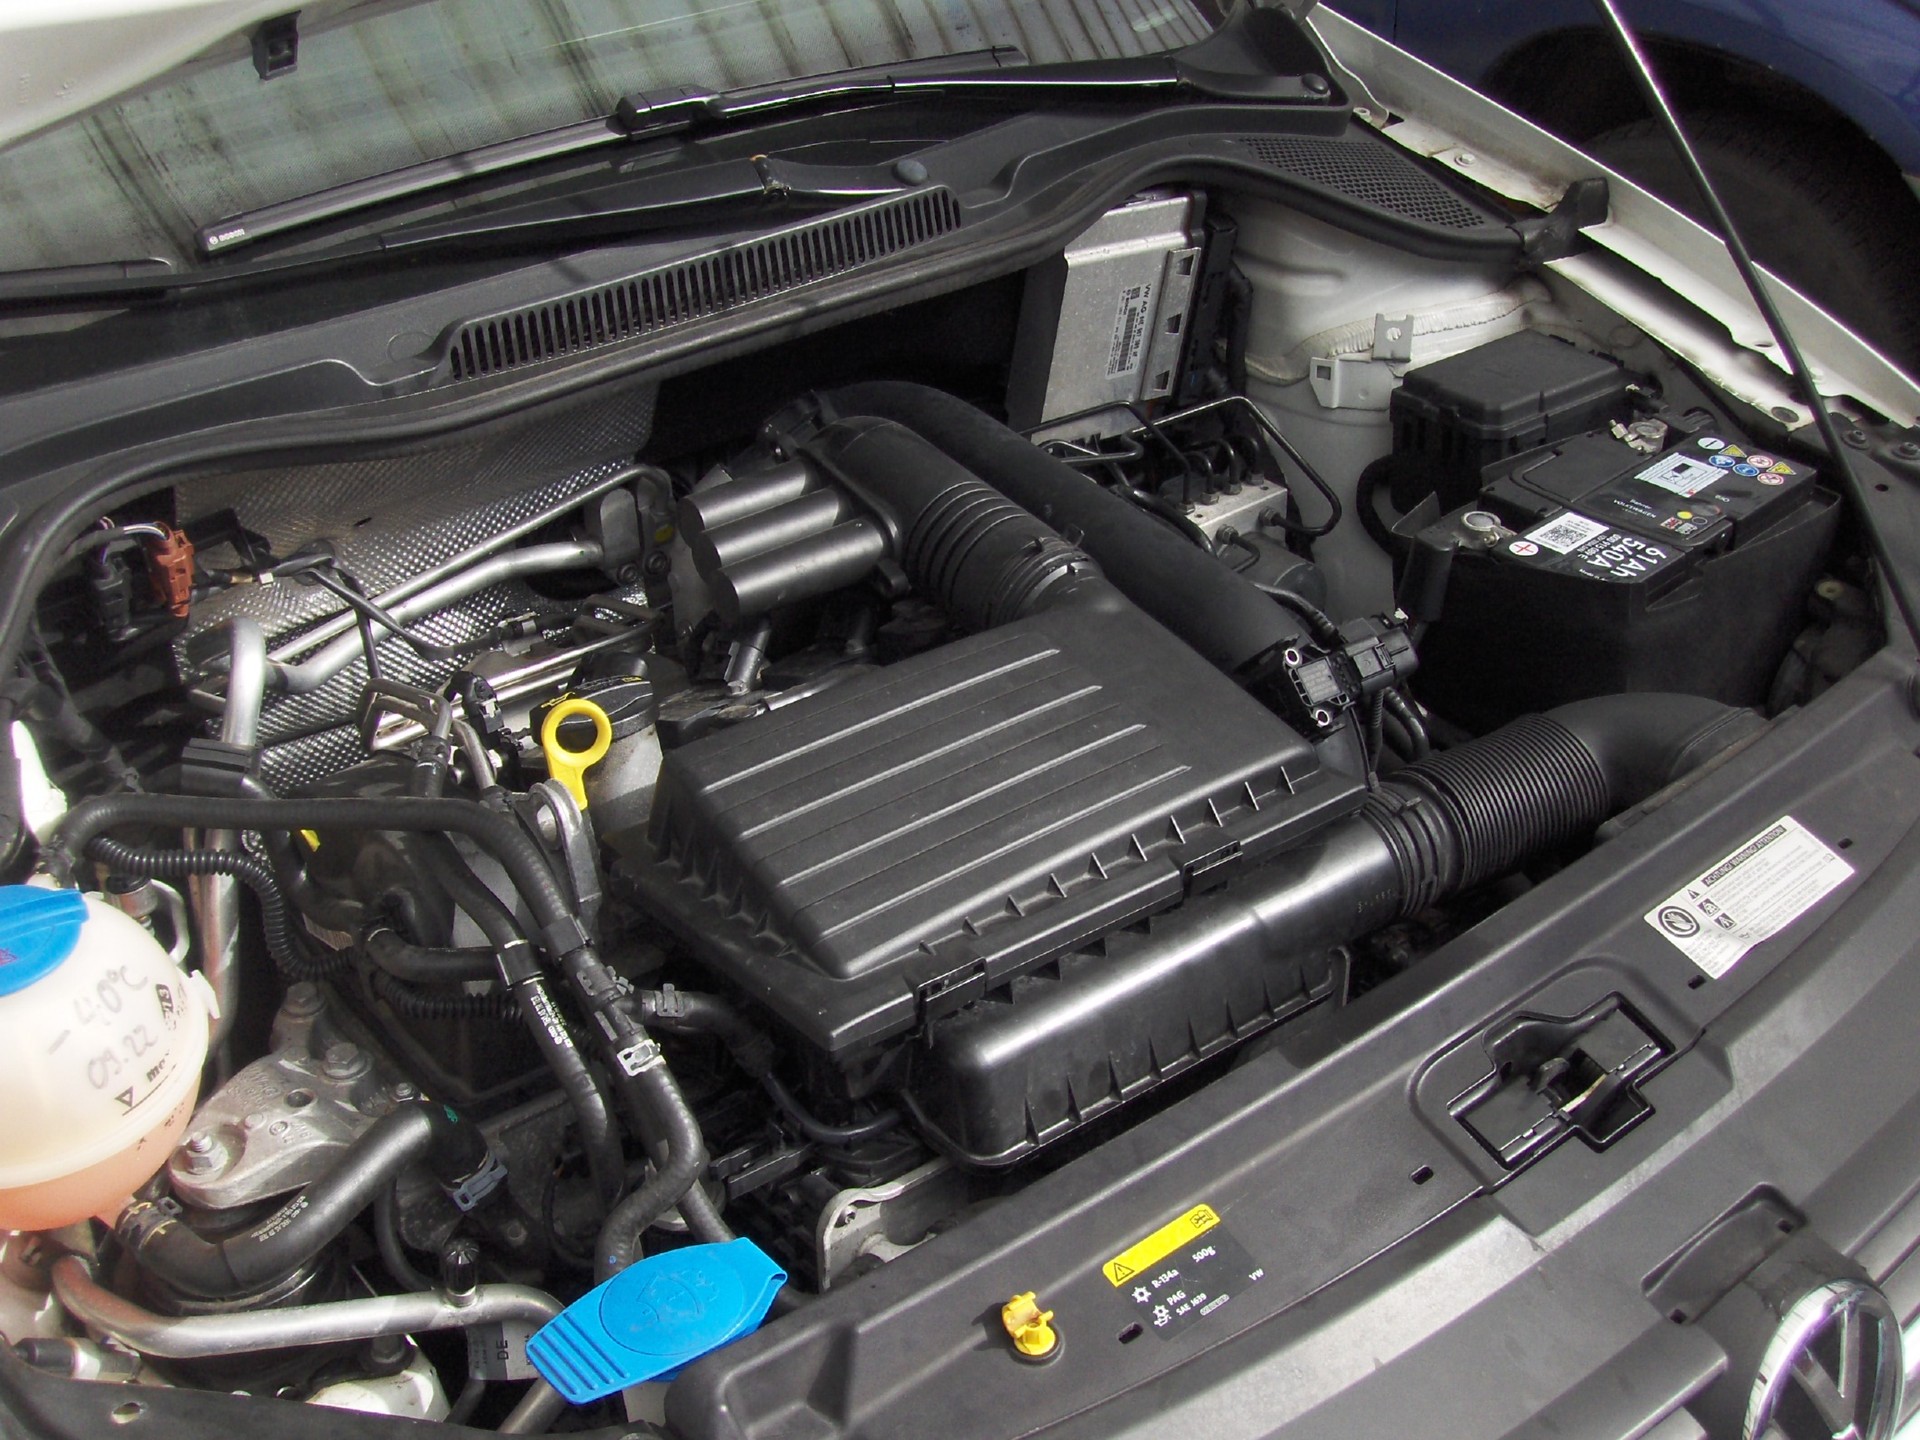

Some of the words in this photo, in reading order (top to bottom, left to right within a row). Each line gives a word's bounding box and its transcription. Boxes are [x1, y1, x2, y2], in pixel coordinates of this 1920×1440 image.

[1587, 537, 1646, 568] 540A
[1610, 547, 1668, 578] 61Ah
[1192, 1246, 1216, 1263] 500g
[1151, 1269, 1180, 1288] R-134a
[1249, 1268, 1264, 1281] VW
[1167, 1290, 1187, 1306] PAG
[1176, 1303, 1191, 1316] SAE
[496, 1340, 509, 1360] DE
